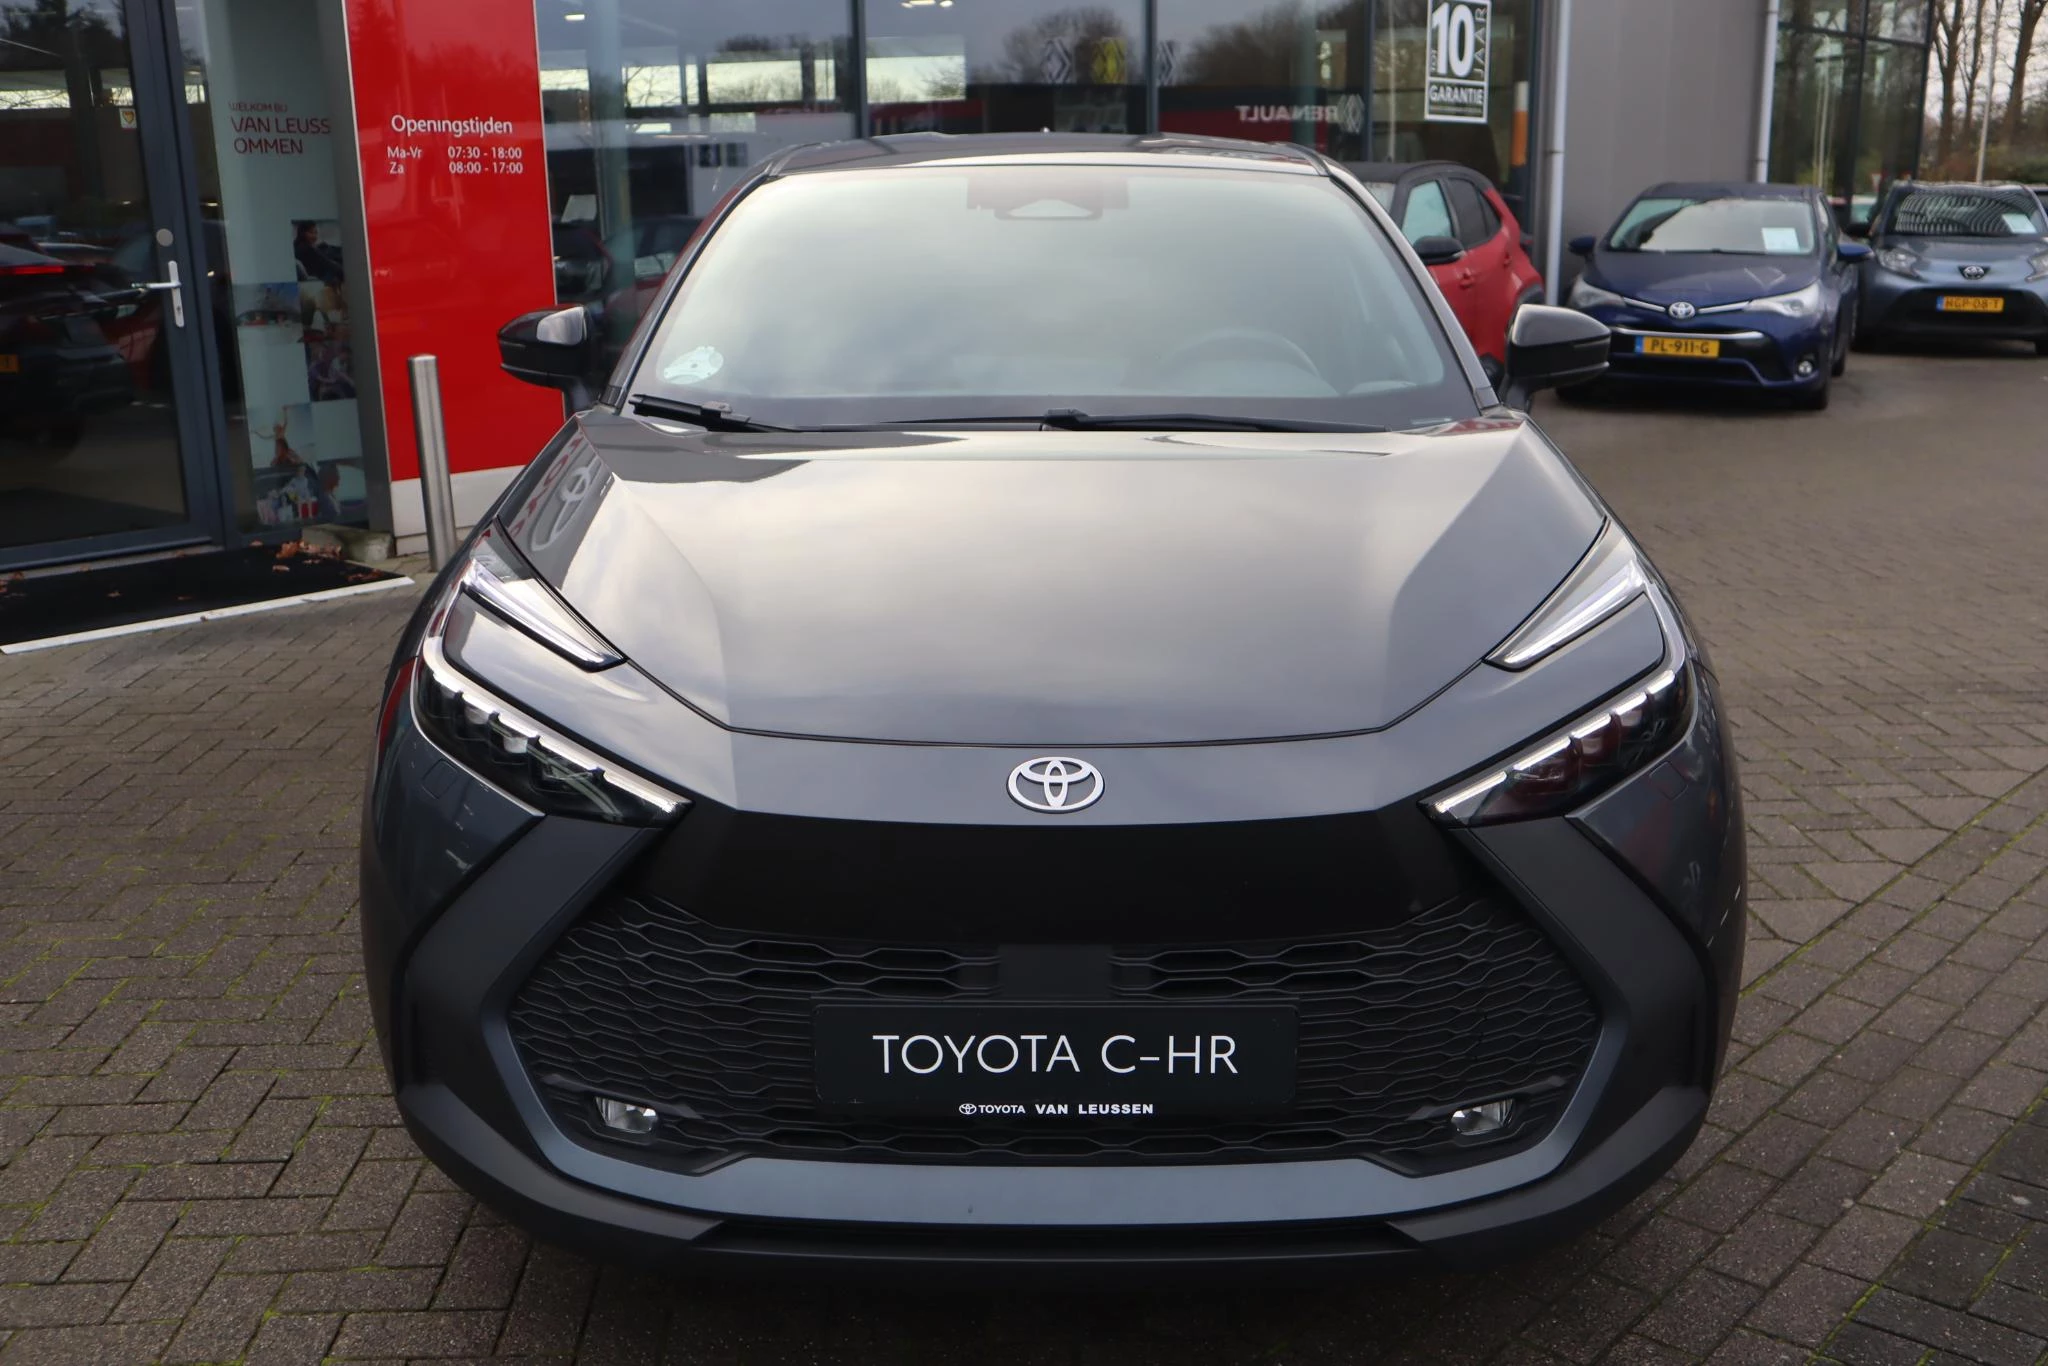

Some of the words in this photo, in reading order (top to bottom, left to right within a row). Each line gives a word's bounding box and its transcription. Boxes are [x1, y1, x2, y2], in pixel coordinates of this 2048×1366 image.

[1432, 2, 1475, 78] 10
[1473, 7, 1487, 79] JAAR
[1430, 84, 1483, 105] GARANTIE
[231, 116, 270, 133] VAN
[391, 114, 513, 137] Openingstijden
[233, 137, 303, 154] OMMEN
[387, 145, 422, 159] Ma-Vr
[447, 146, 480, 159] 07:30
[491, 146, 522, 159] 18:00
[389, 161, 404, 174] Za
[448, 161, 481, 174] 08:00
[492, 162, 523, 174] 17:00
[1651, 338, 1710, 354] PL-911-G
[872, 1034, 1081, 1074] TOYOTA
[1101, 1034, 1239, 1074] C-HR
[978, 1104, 1026, 1114] TOYOTA
[1035, 1104, 1068, 1115] VAN
[1078, 1103, 1154, 1115] LEUSSEN
